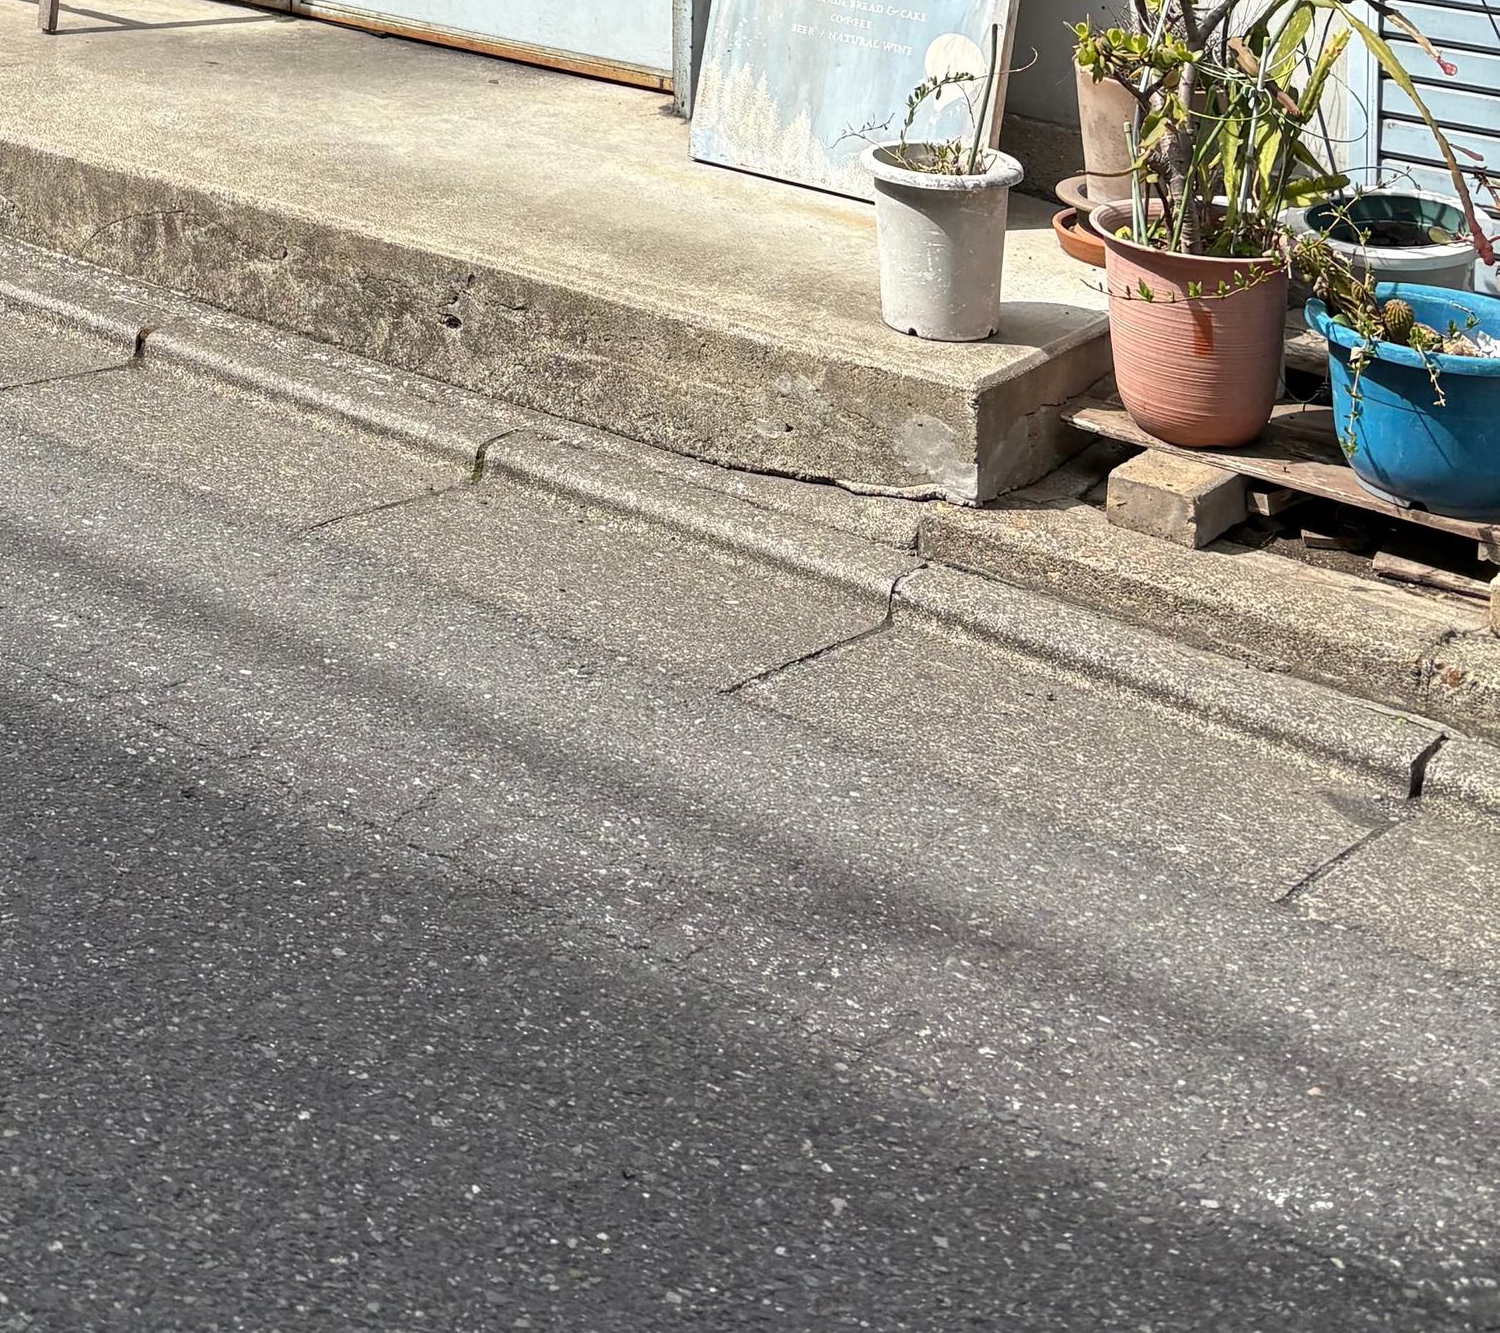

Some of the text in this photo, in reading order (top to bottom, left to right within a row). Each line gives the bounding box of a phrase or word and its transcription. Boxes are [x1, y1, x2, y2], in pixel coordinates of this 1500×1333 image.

[830, 13, 874, 29] COFFEE
[850, 0, 884, 14] BREAD
[886, 6, 899, 16] &
[900, 9, 927, 22] CAKE
[791, 23, 815, 36] BEER
[828, 31, 880, 49] NATURAL
[882, 41, 913, 56] WINE
